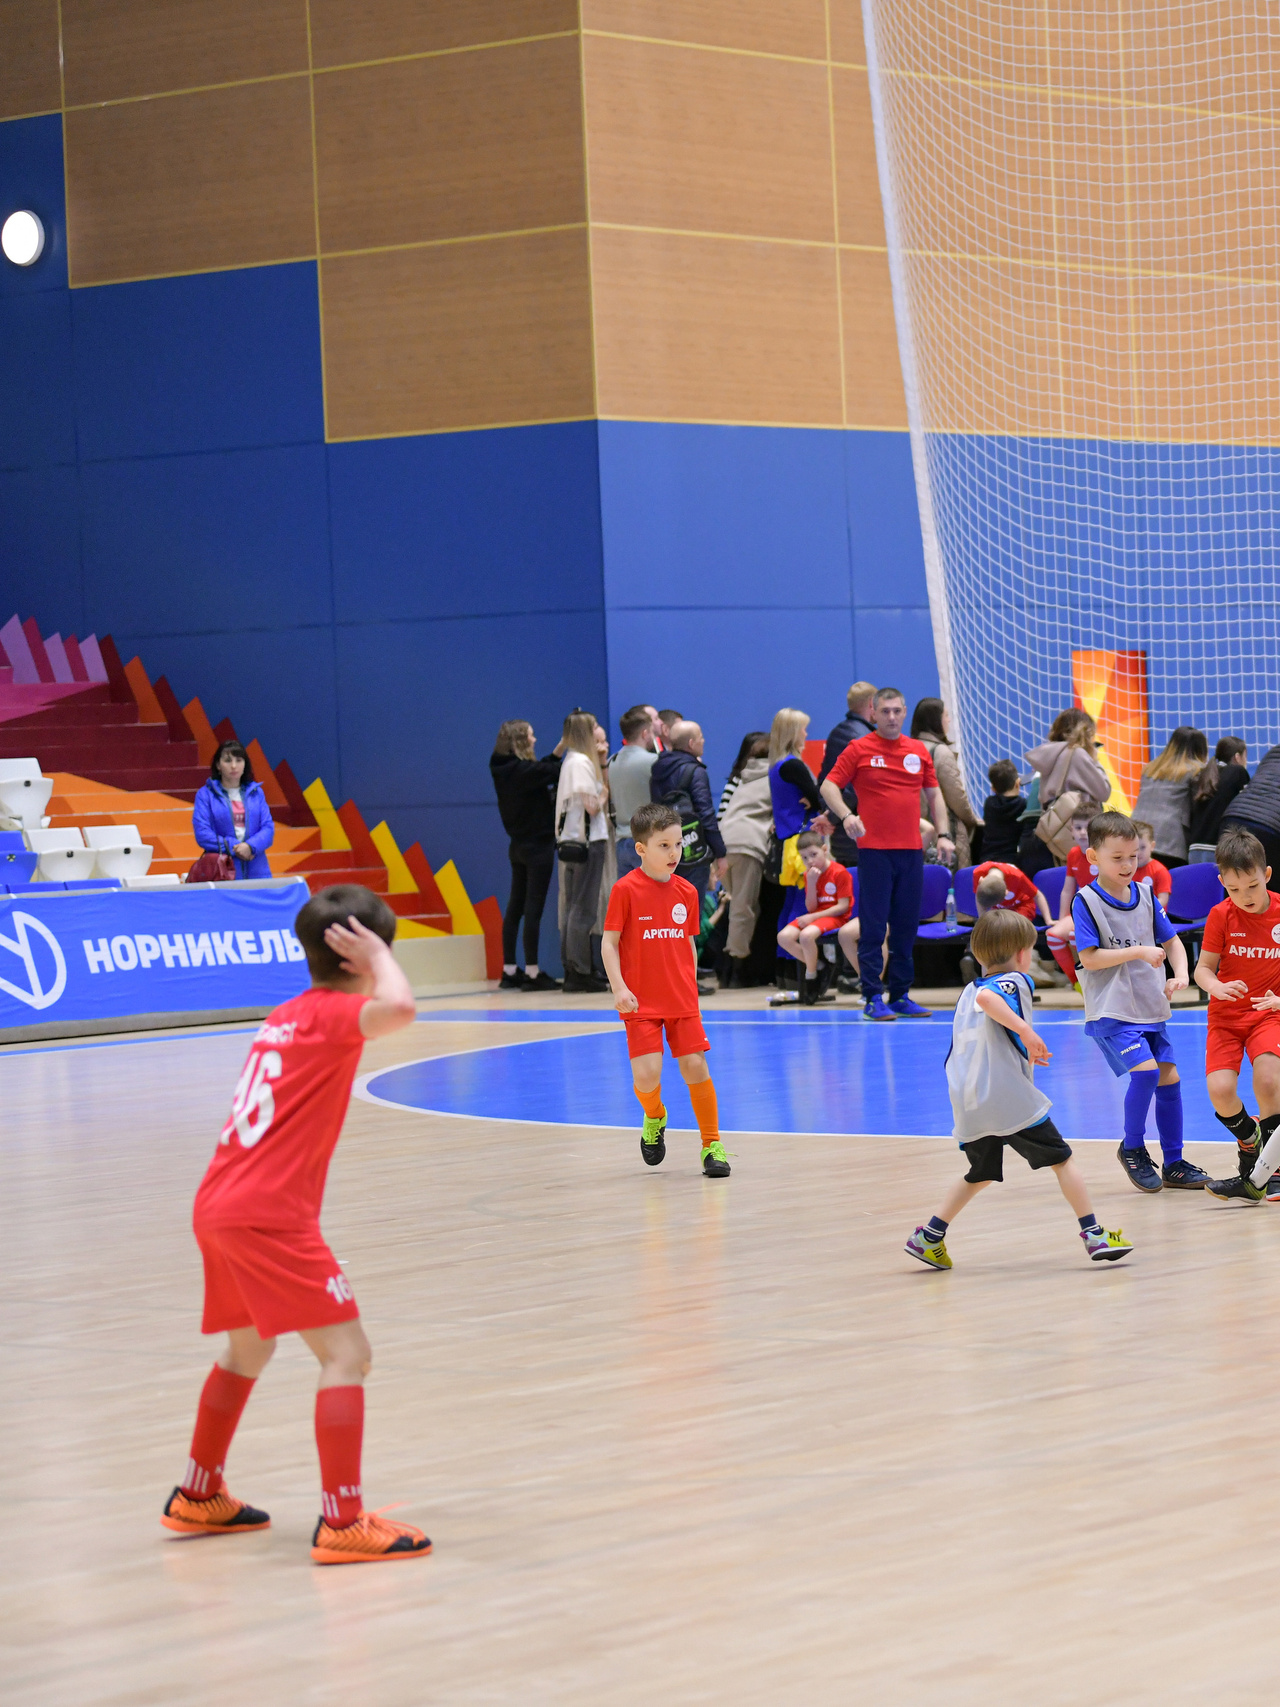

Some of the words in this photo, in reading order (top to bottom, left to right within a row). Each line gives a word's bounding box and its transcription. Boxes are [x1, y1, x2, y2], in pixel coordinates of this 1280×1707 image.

[82, 928, 308, 974] НОРНИКЕЛЬ
[642, 928, 685, 940] АРКТИКА
[220, 1049, 284, 1150] 16
[326, 1273, 353, 1305] 16
